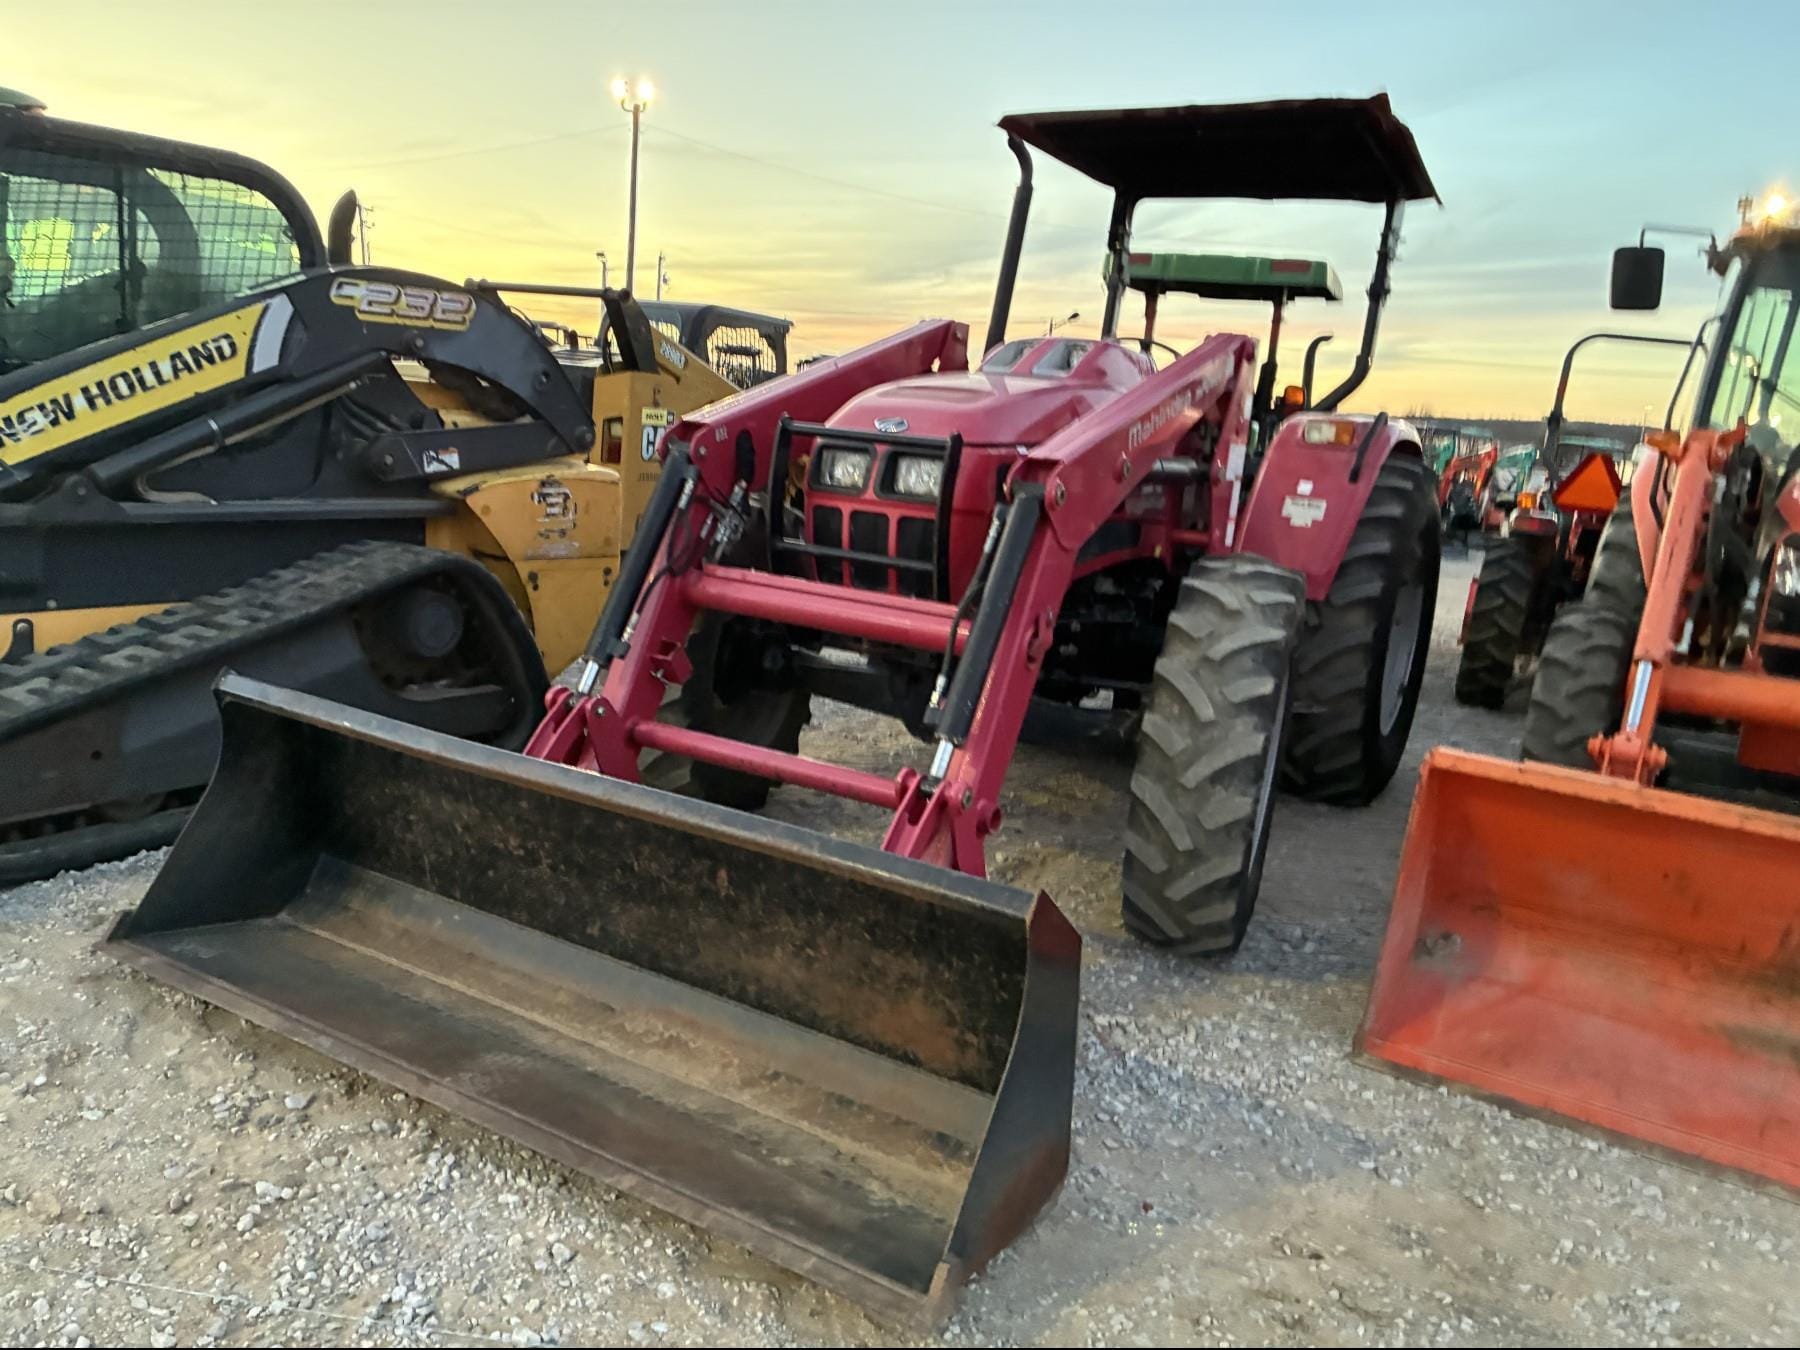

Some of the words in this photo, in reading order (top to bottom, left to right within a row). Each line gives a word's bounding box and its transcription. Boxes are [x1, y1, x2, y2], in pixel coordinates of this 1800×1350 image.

[330, 277, 476, 328] C232
[0, 393, 76, 448] NEW
[80, 332, 238, 412] HOLLAND
